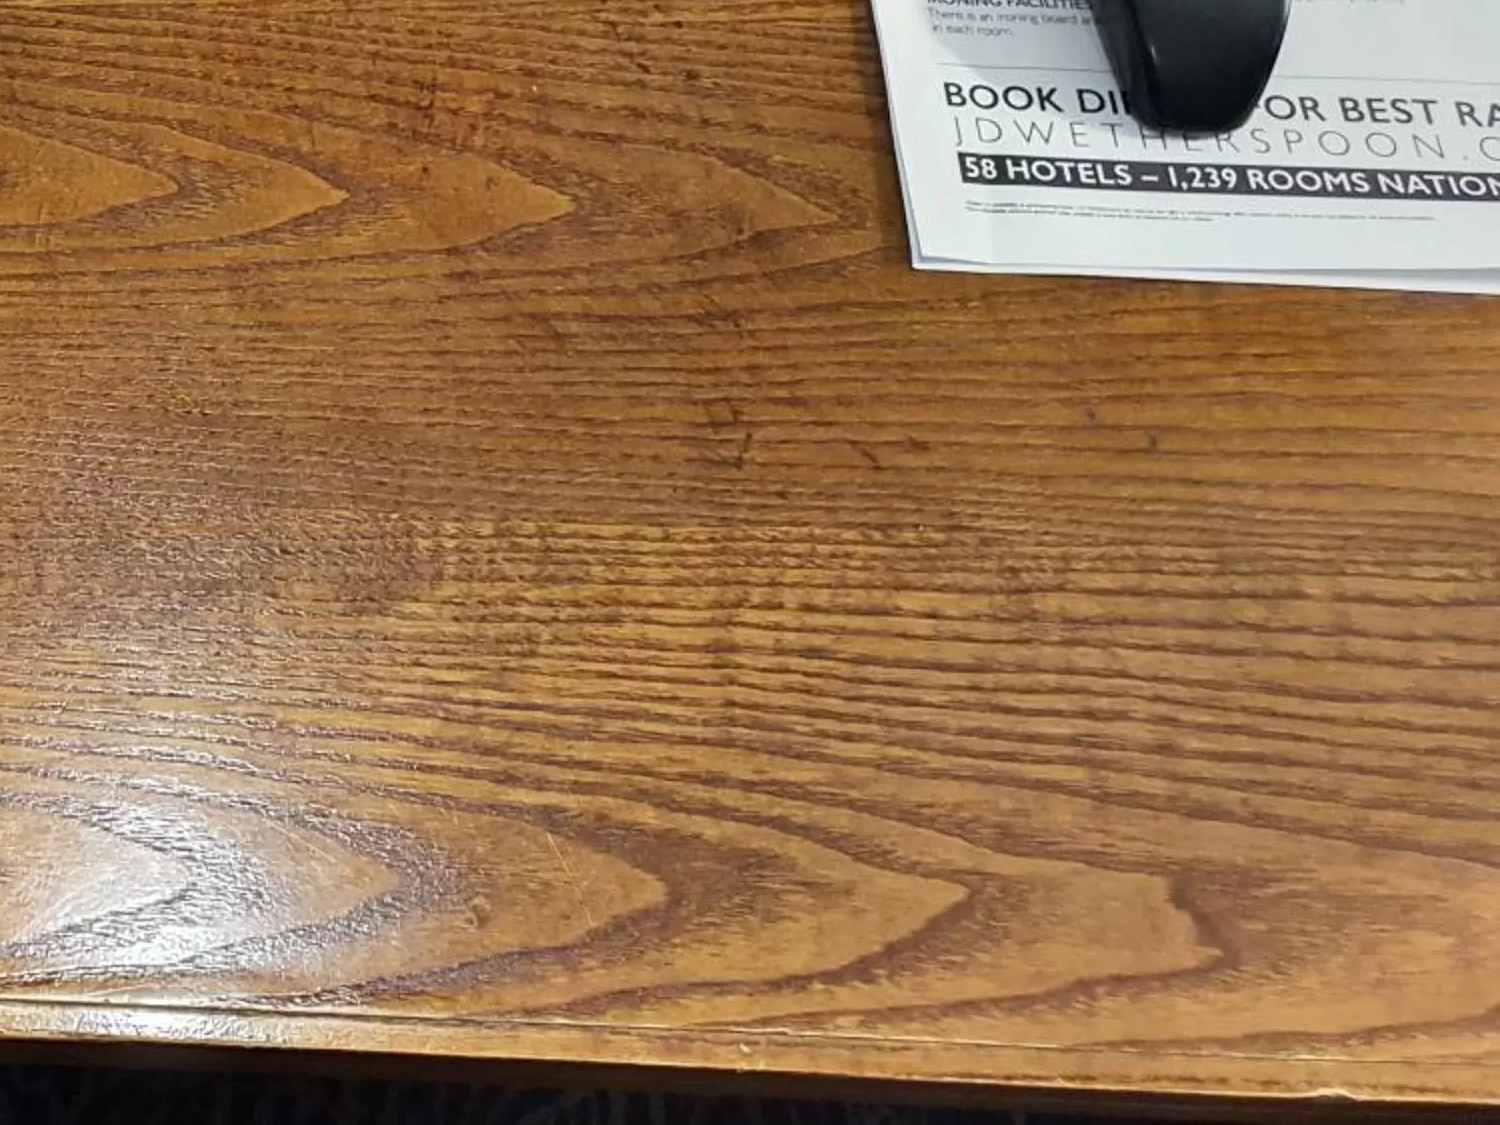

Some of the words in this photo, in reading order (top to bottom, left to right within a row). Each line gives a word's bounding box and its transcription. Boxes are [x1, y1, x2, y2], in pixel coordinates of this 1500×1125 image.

[943, 81, 1064, 114] BOOK
[1257, 94, 1328, 123] OR
[1337, 96, 1439, 126] BEST
[965, 156, 998, 180] 58
[1004, 157, 1134, 187] HOTELS
[1167, 165, 1238, 192] 1,239
[1245, 167, 1372, 195] ROOMS
